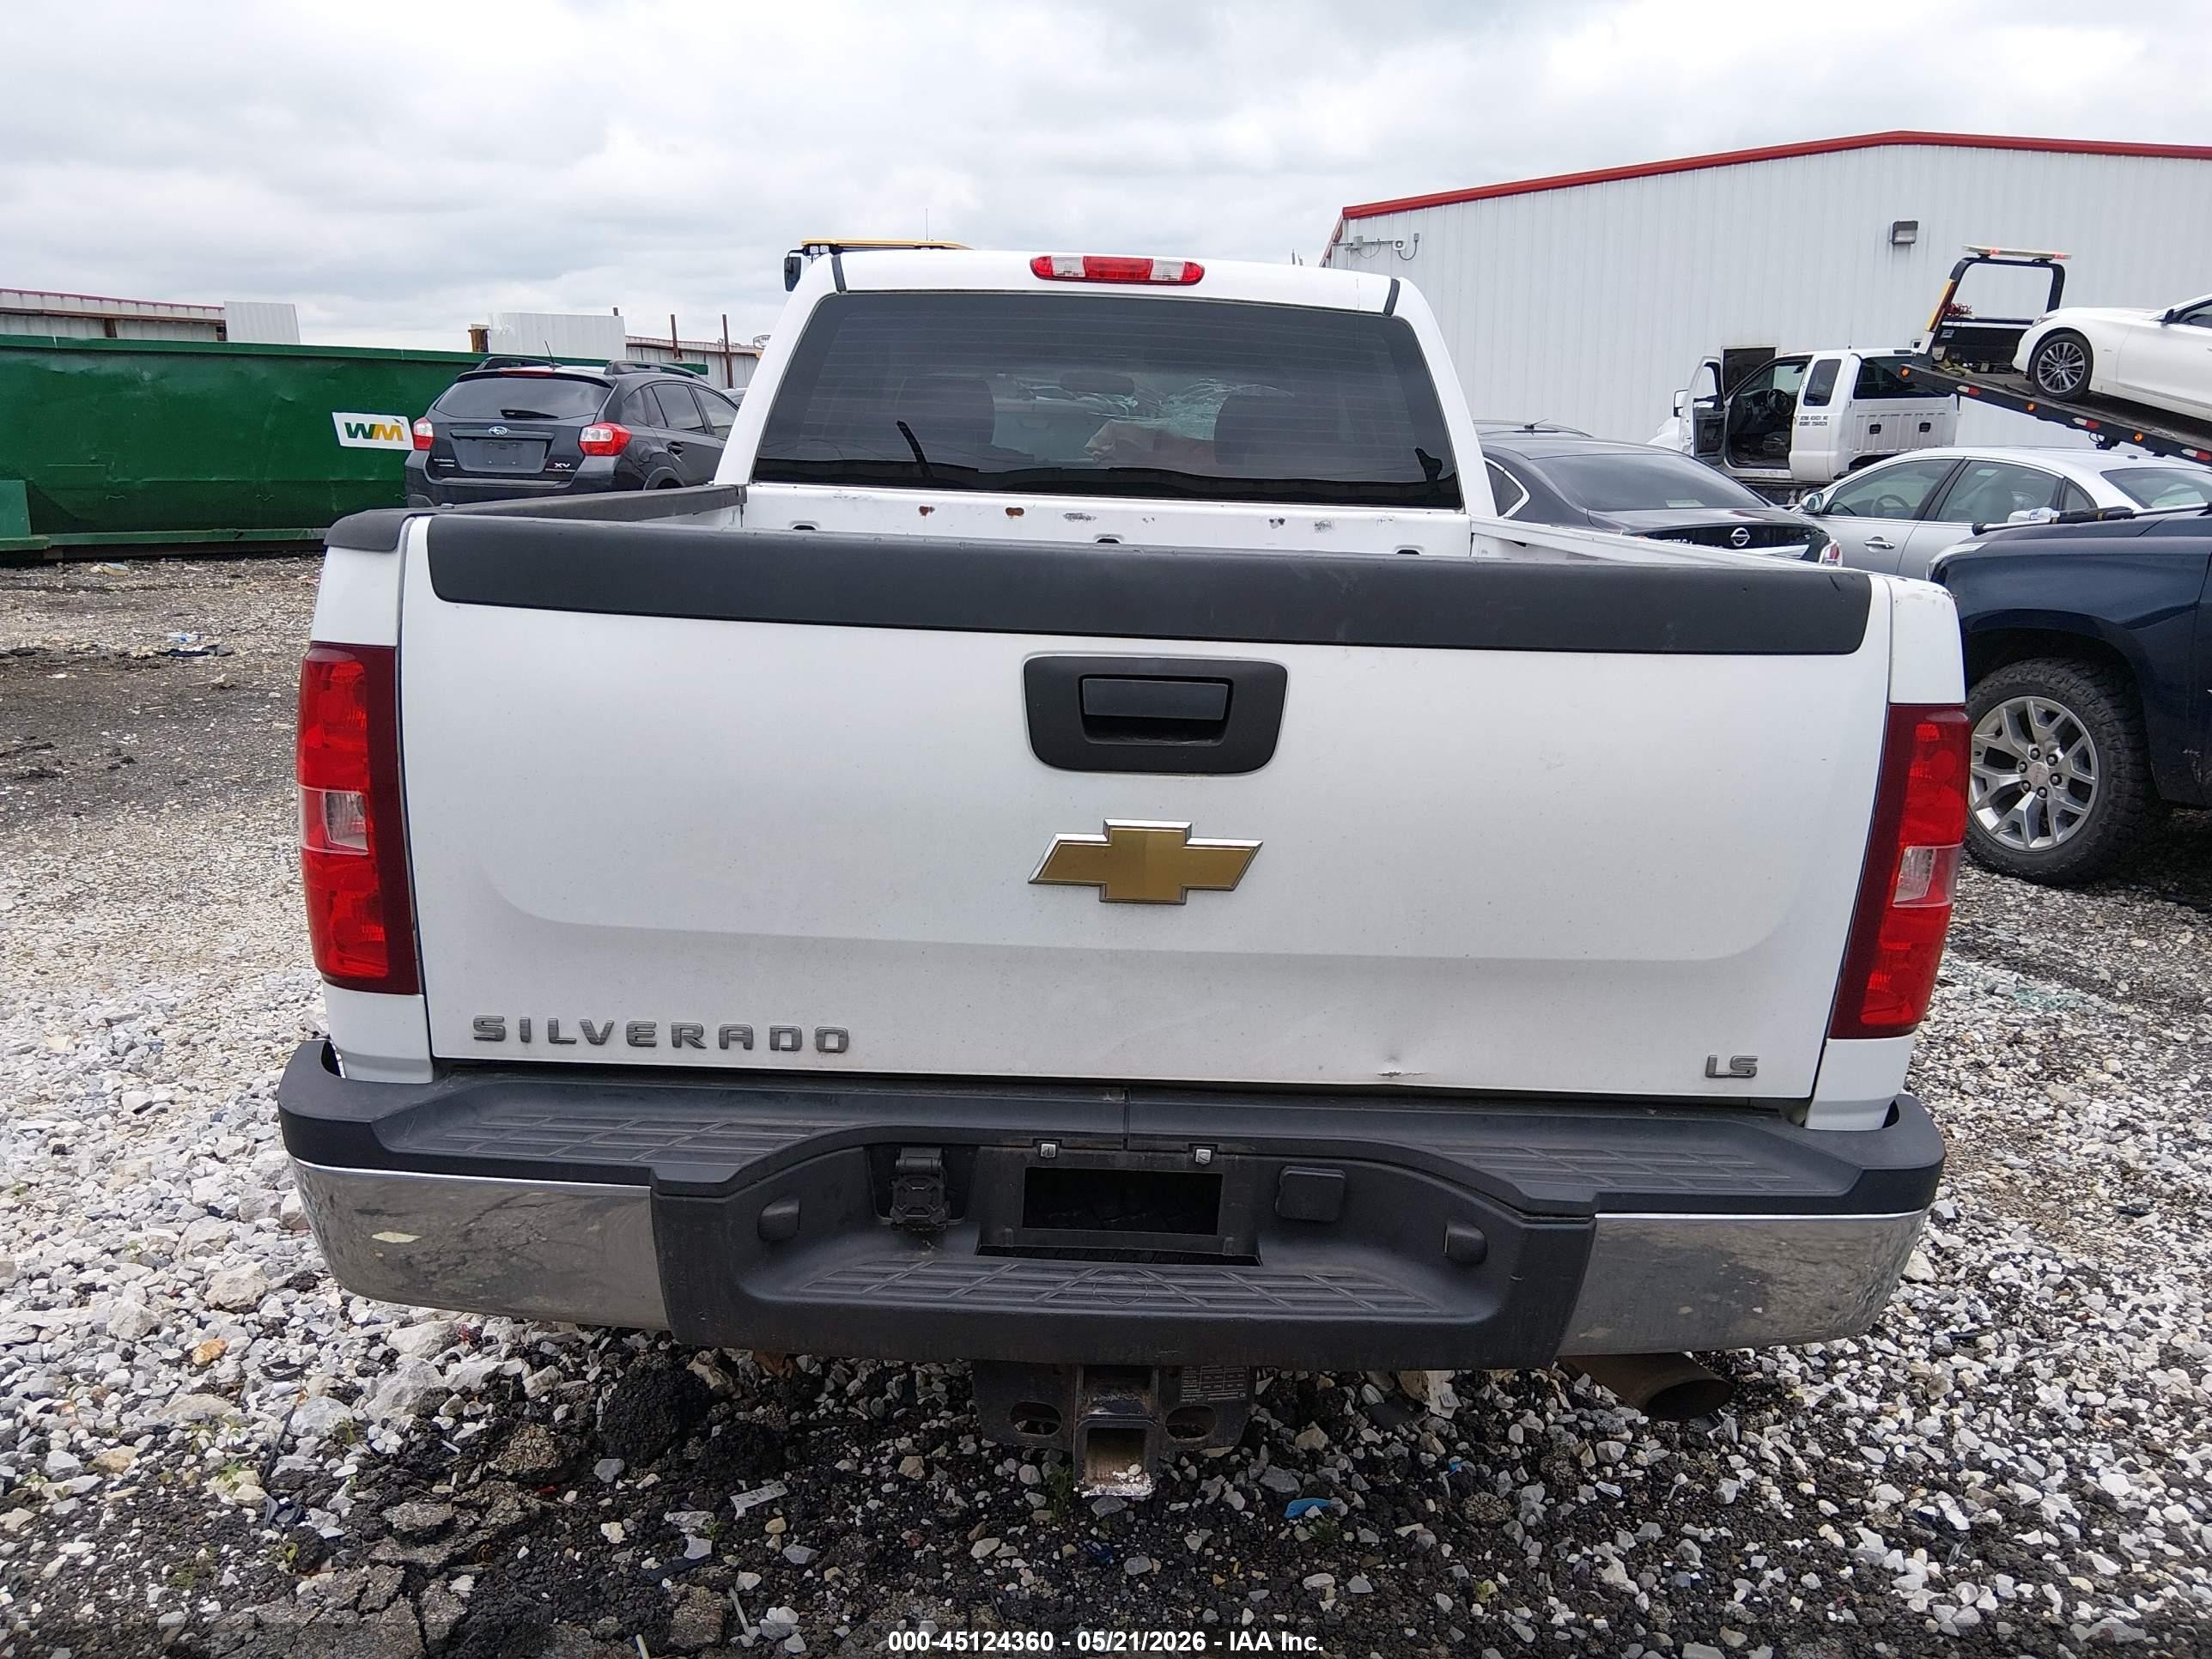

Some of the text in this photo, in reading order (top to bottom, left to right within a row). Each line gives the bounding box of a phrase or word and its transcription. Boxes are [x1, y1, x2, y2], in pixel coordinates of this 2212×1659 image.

[343, 422, 404, 441] WM
[473, 1015, 850, 1053] SILVERADO
[1705, 1054, 1759, 1079] LS
